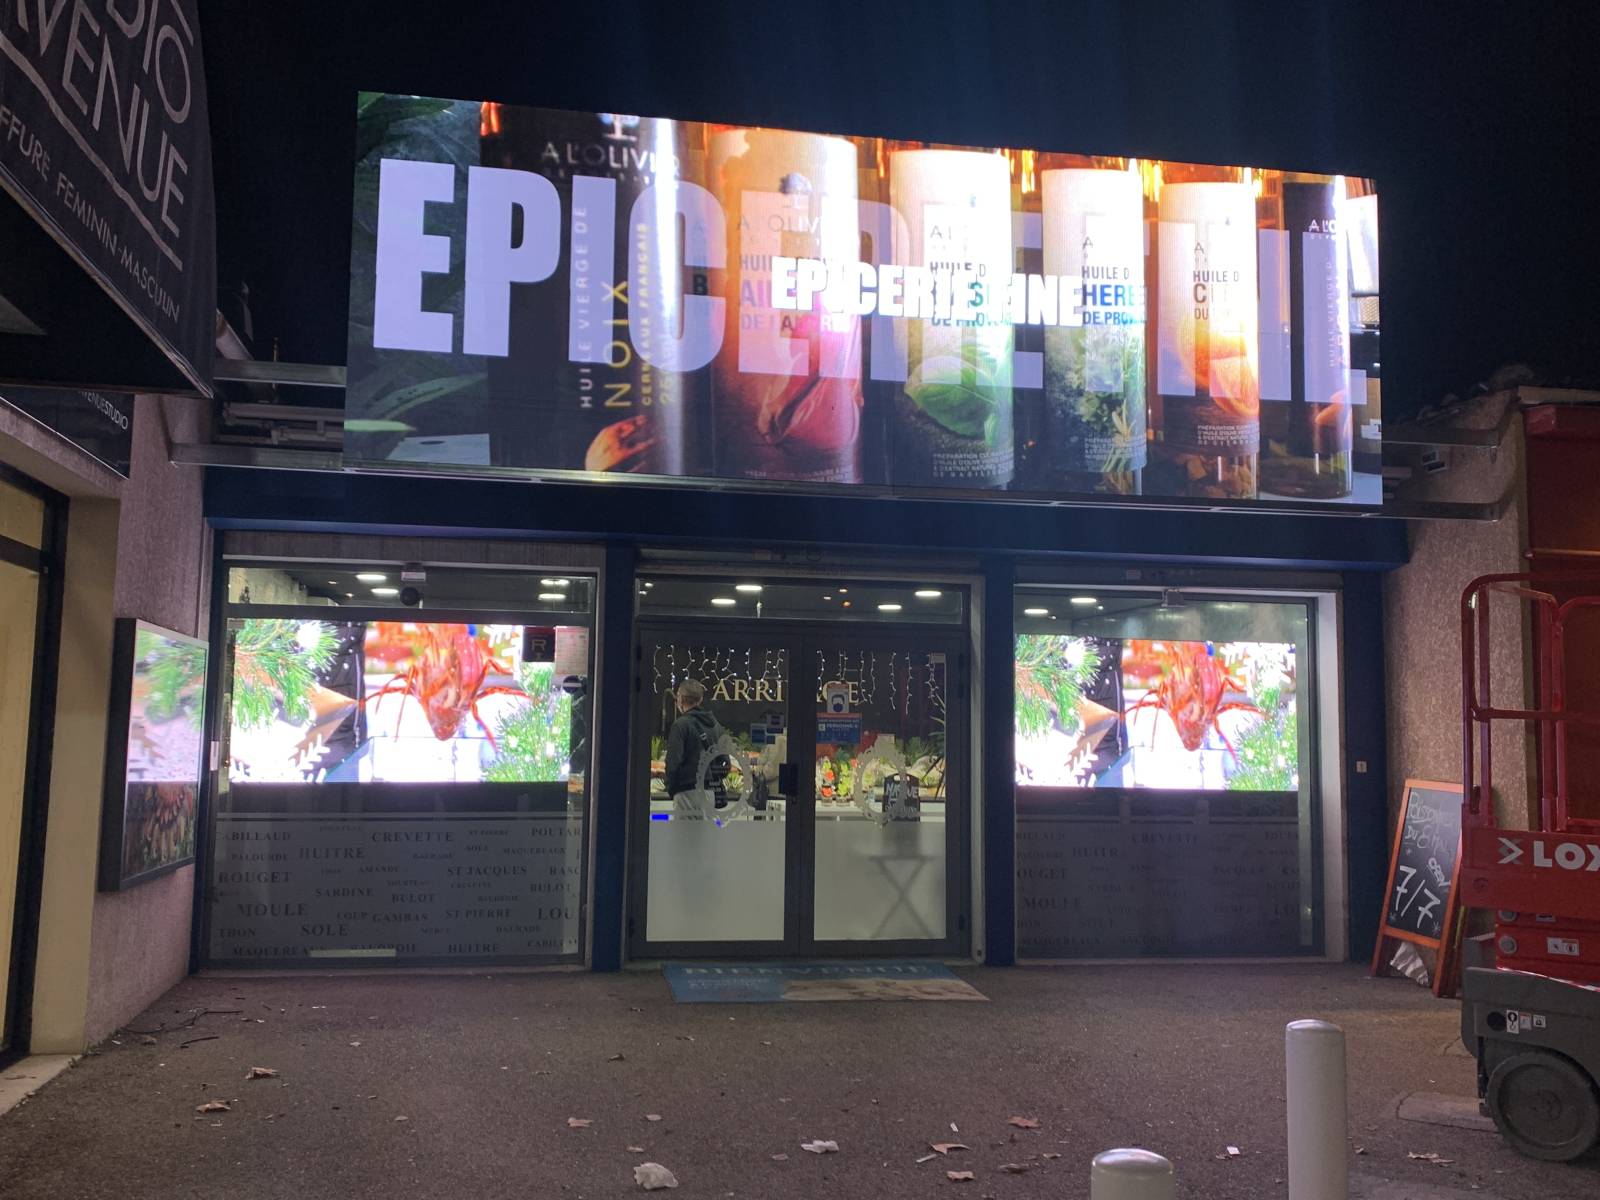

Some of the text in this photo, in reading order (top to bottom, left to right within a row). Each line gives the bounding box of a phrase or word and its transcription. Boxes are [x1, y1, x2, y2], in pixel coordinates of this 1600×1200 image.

[1081, 265, 1118, 280] HUILE
[1192, 270, 1228, 283] HUILE
[601, 280, 633, 408] NOIX
[80, 391, 129, 430] VENUESTUDIO
[371, 831, 454, 843] CREVETTE
[298, 847, 367, 860] HUITRE
[1394, 864, 1441, 930] 7/7
[237, 903, 309, 918] MOULE
[300, 923, 351, 938] SOLE
